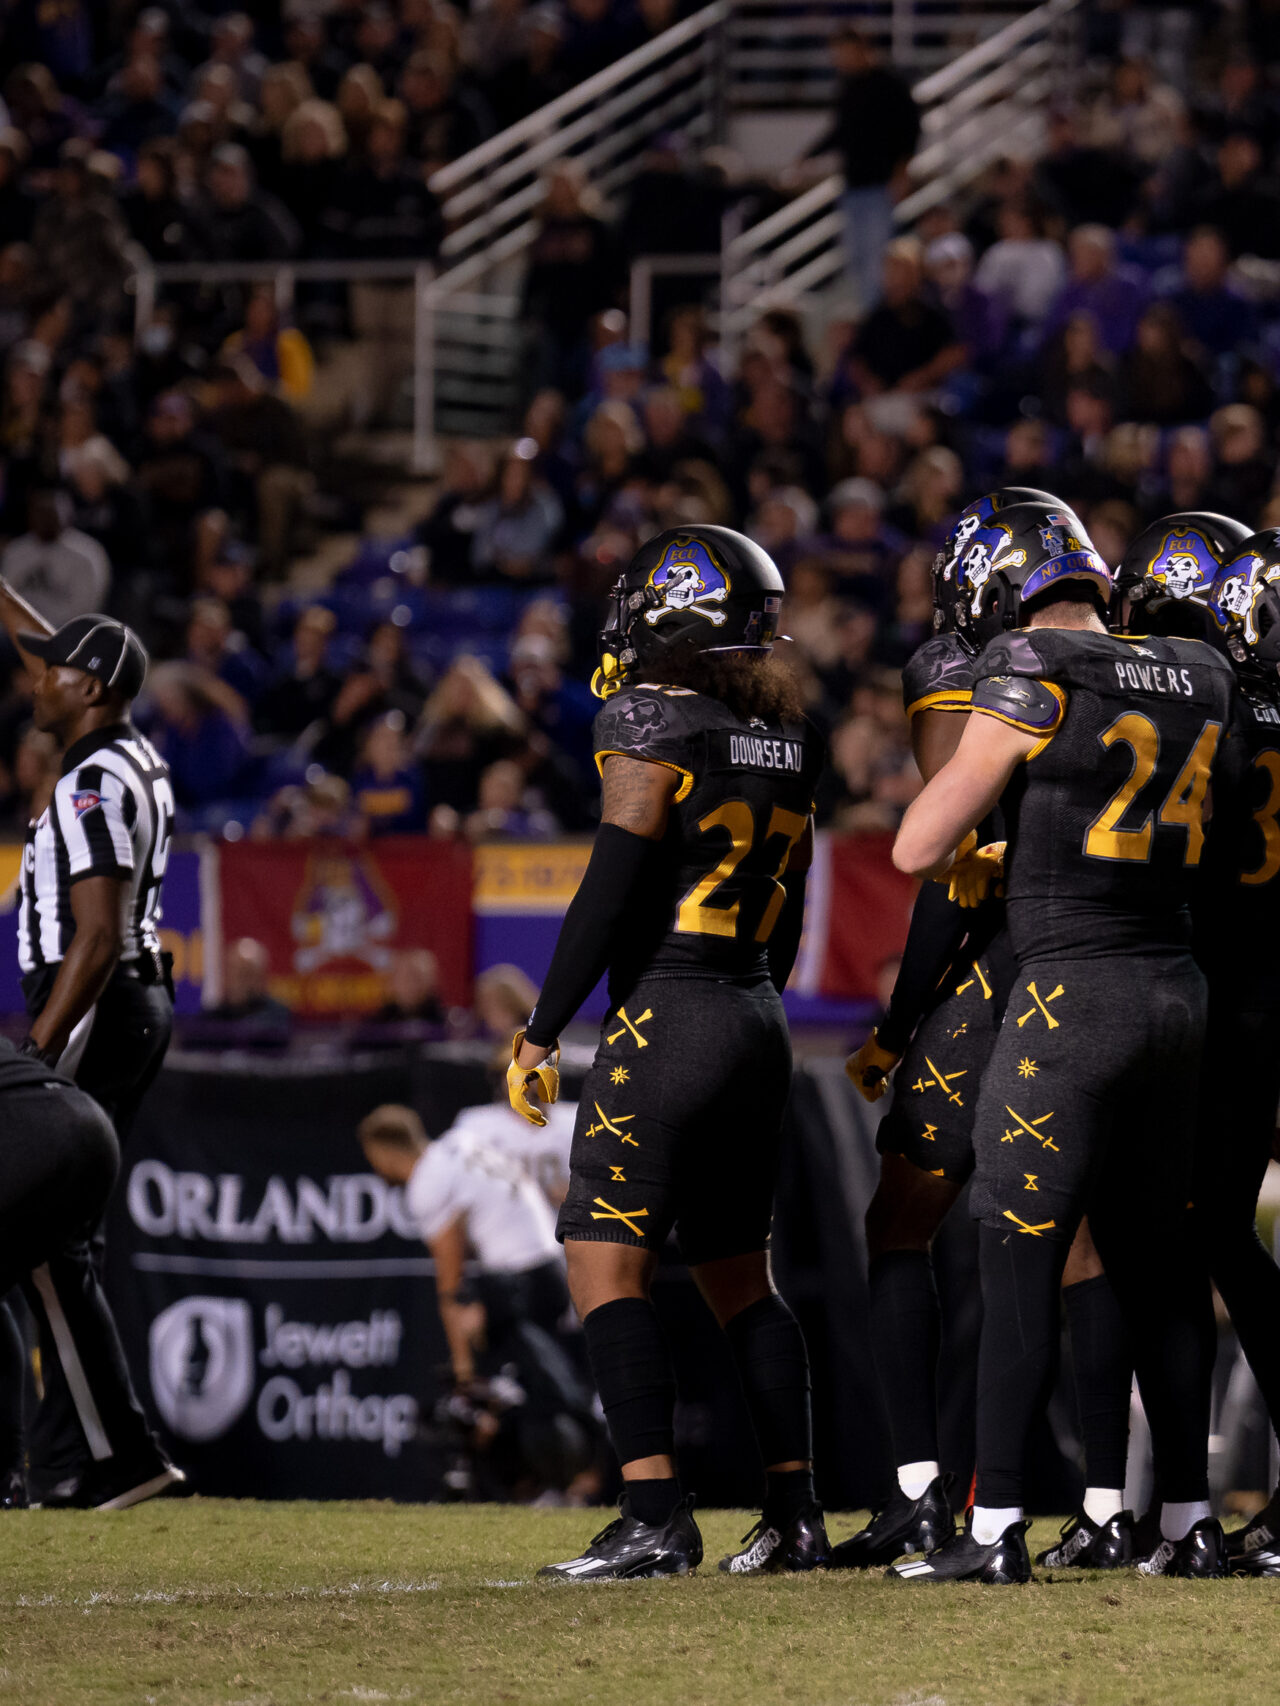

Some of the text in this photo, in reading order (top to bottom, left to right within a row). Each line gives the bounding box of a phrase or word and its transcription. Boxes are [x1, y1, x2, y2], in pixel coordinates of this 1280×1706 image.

[669, 548, 698, 561] ECU
[1169, 539, 1196, 550] ECU
[1041, 561, 1062, 580] NO
[1115, 661, 1194, 697] POWERS
[729, 735, 803, 773] DOURSEAU
[1082, 710, 1223, 869] 24
[673, 796, 810, 943] 27
